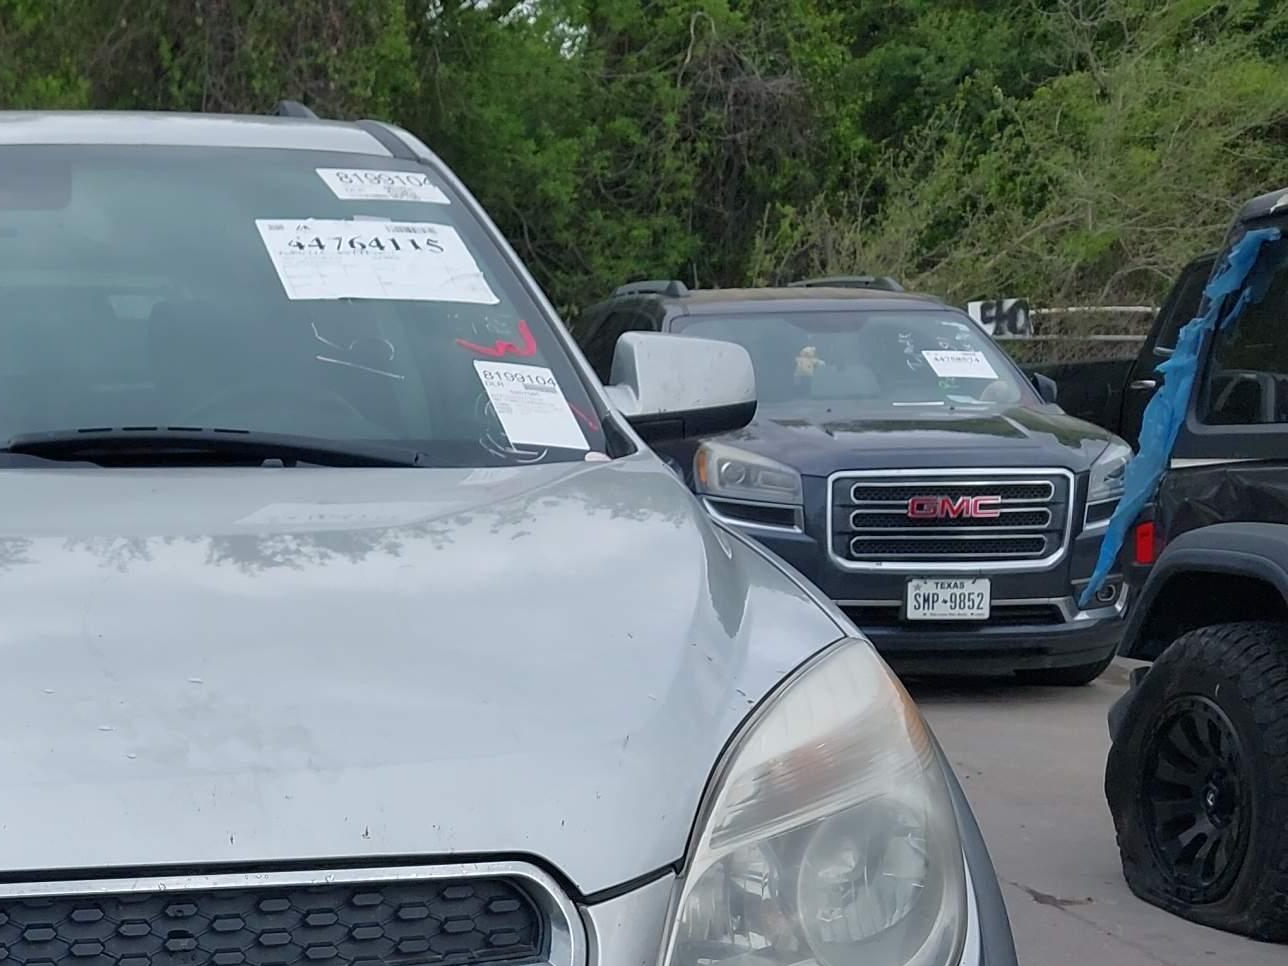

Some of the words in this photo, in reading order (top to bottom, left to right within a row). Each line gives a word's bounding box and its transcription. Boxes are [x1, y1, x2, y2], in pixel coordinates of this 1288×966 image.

[287, 235, 445, 253] 44764115
[482, 369, 557, 386] 8199104
[908, 495, 1002, 518] GMC
[933, 581, 965, 590] TEXAS
